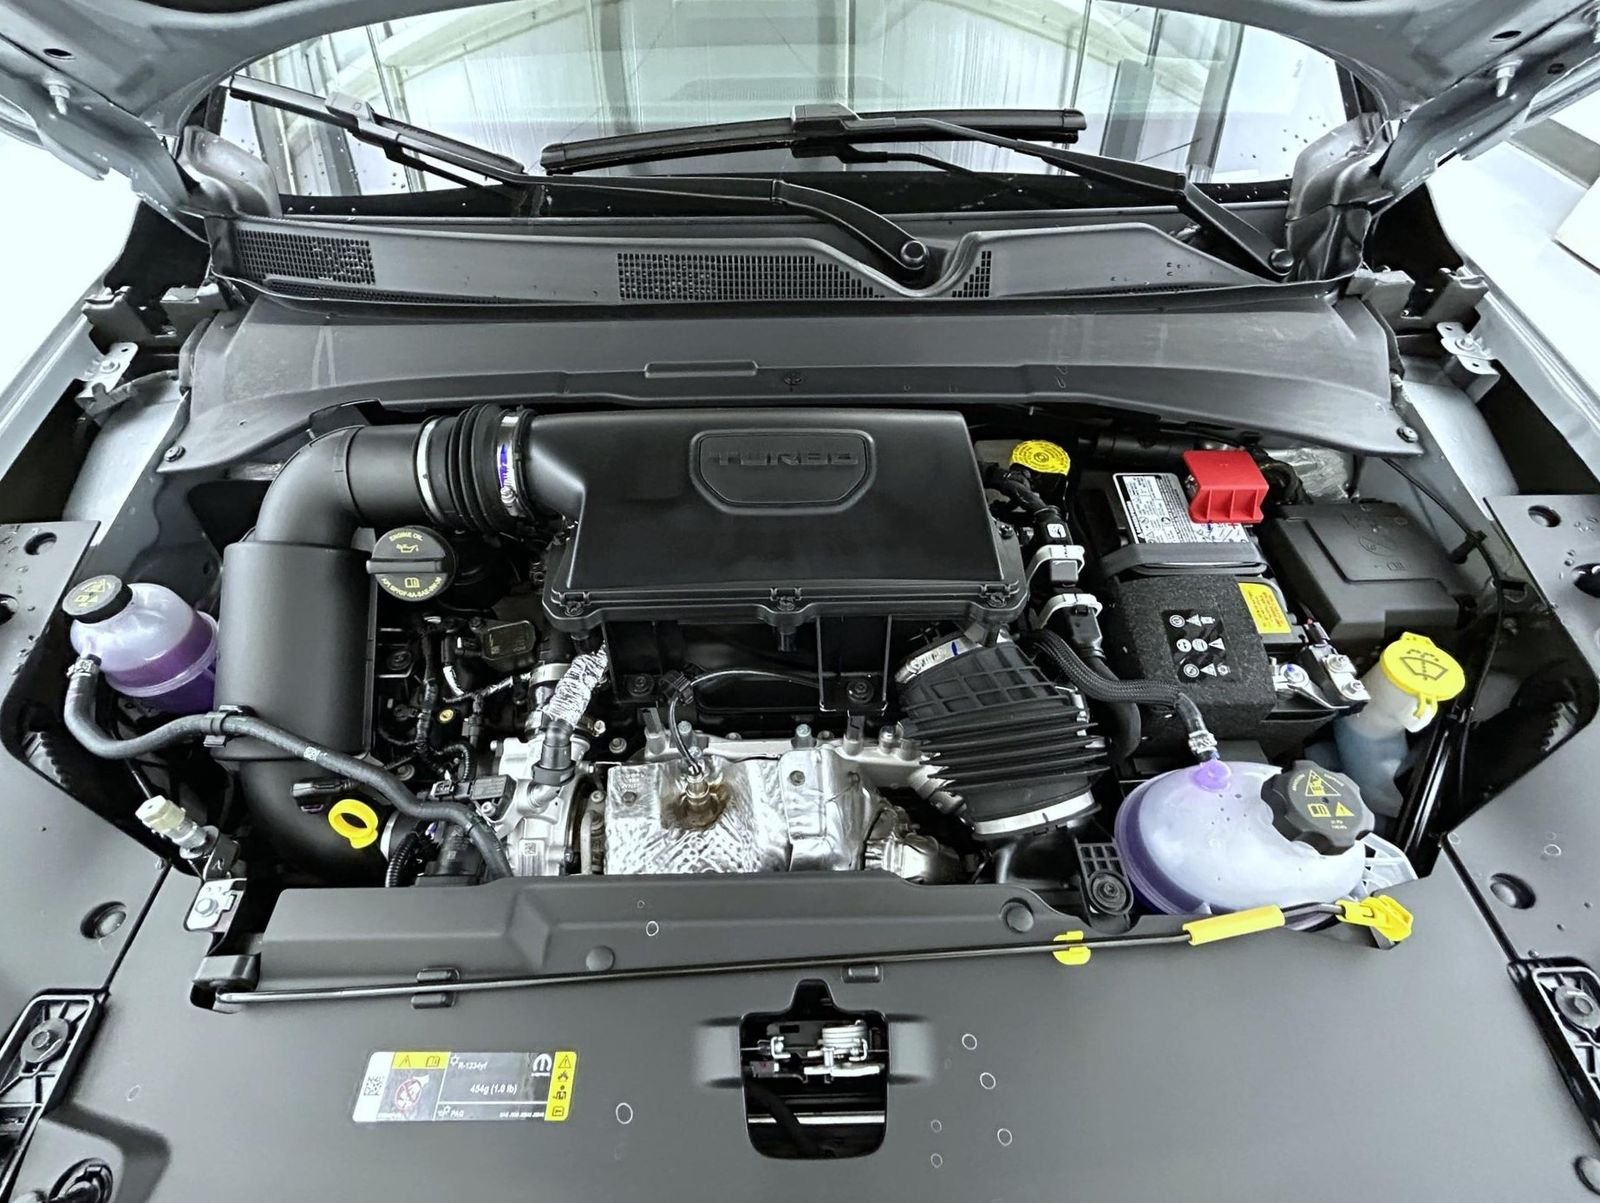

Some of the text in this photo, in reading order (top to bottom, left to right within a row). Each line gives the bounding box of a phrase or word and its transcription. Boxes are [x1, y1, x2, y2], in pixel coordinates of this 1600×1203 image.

[709, 451, 859, 467] TURBO
[470, 1083, 518, 1096] 454g (1.0 lb)
